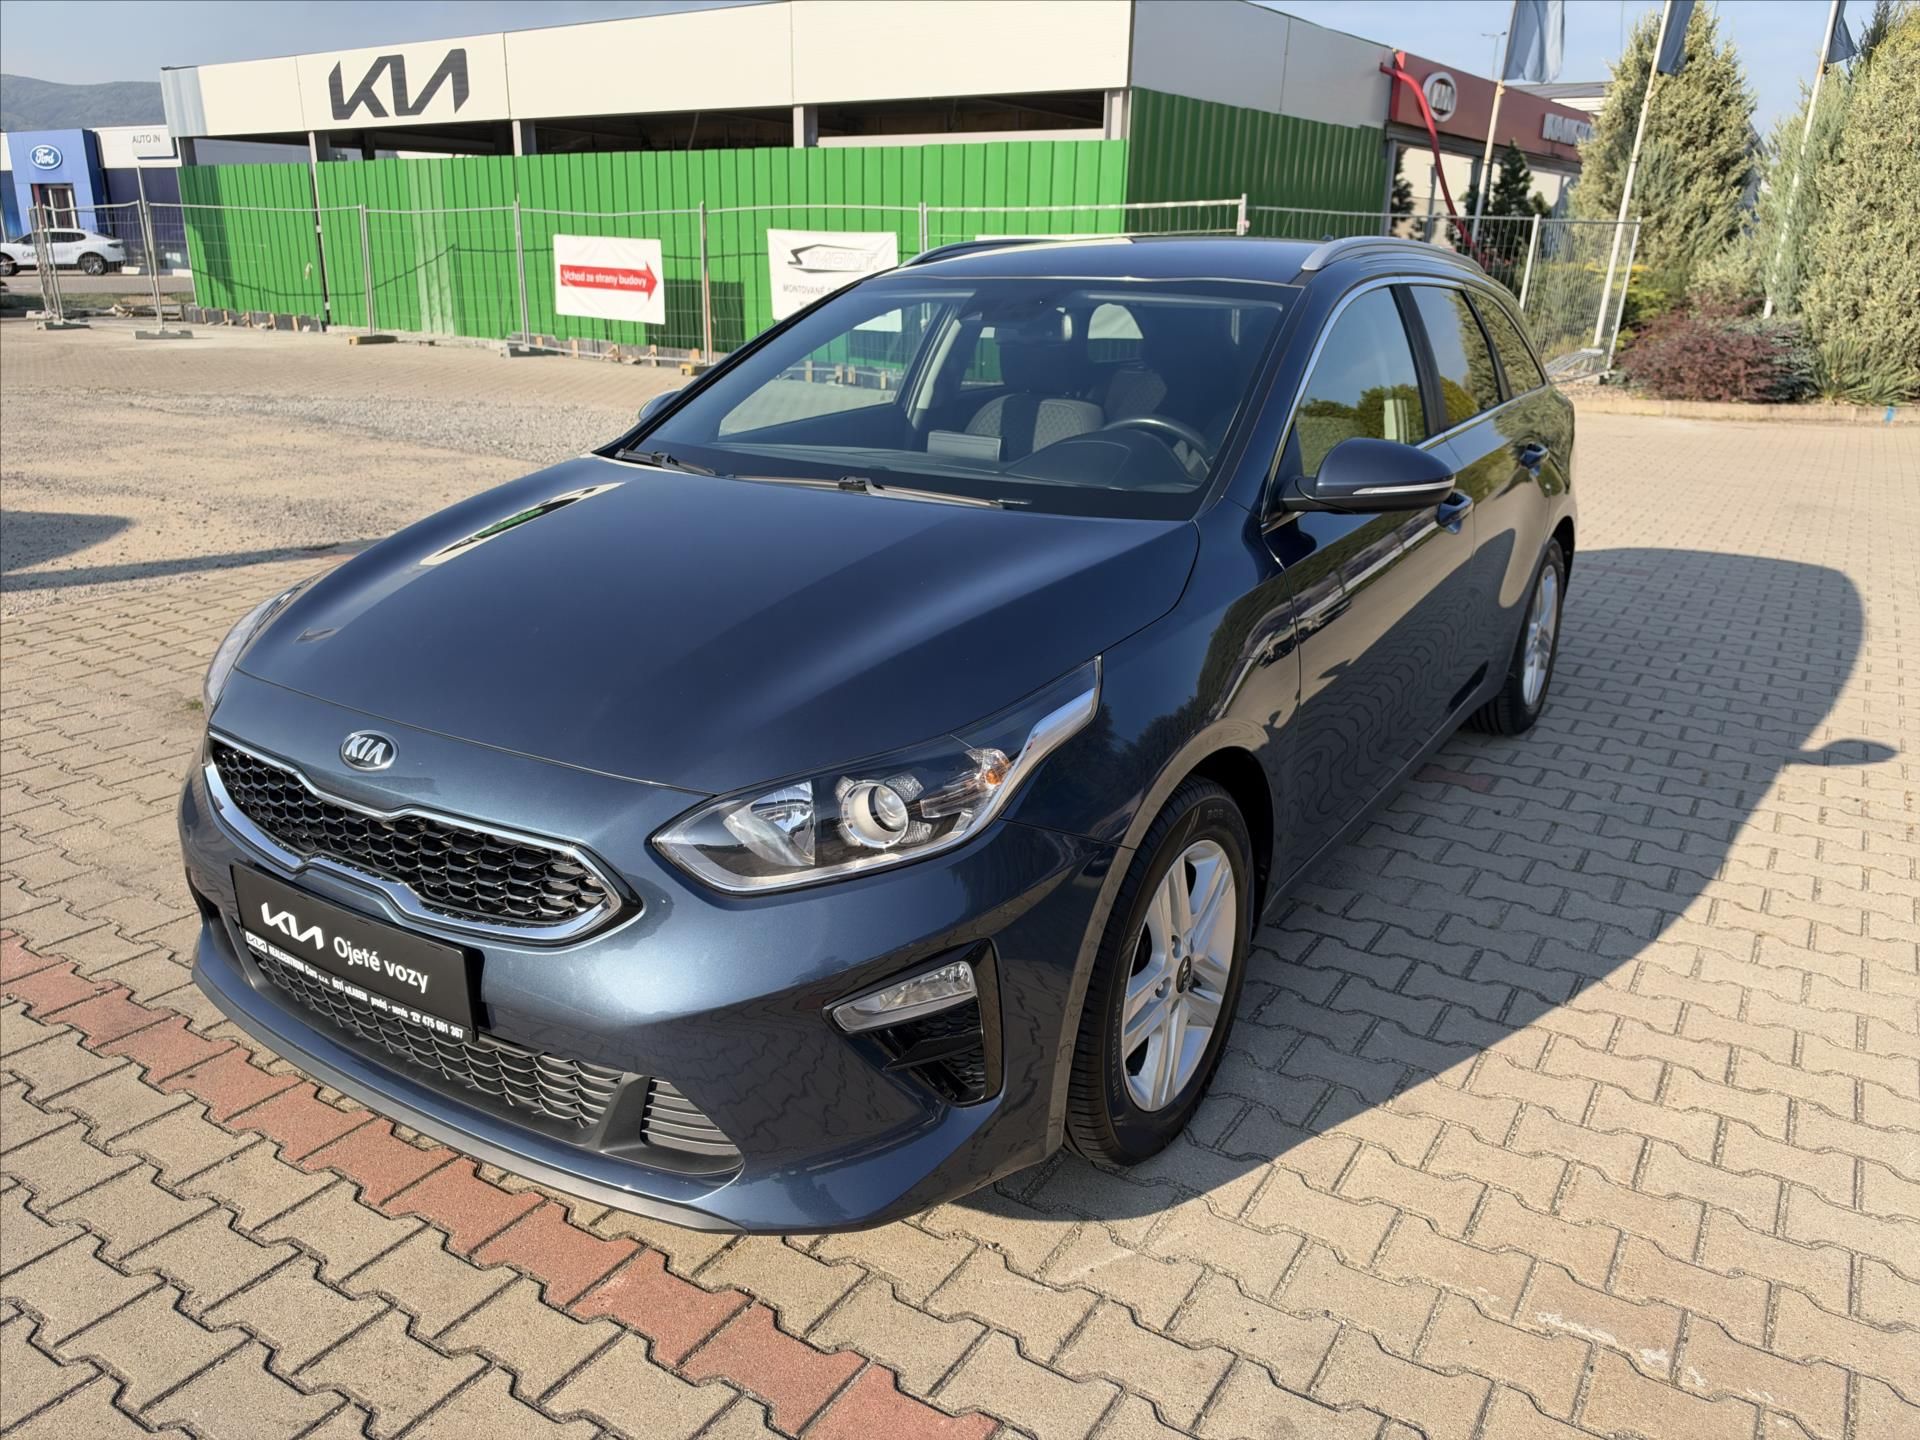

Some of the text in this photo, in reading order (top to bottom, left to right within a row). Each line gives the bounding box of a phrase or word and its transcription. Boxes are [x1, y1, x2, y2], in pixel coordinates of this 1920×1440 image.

[328, 48, 470, 120] KIA
[132, 134, 161, 144] AUTO IN
[562, 269, 586, 281] Vchod
[595, 273, 619, 287] strany
[618, 274, 648, 289] budovy
[344, 734, 387, 766] KIA
[260, 902, 428, 994] KIA Ojeté vozy
[421, 1015, 435, 1029] 475
